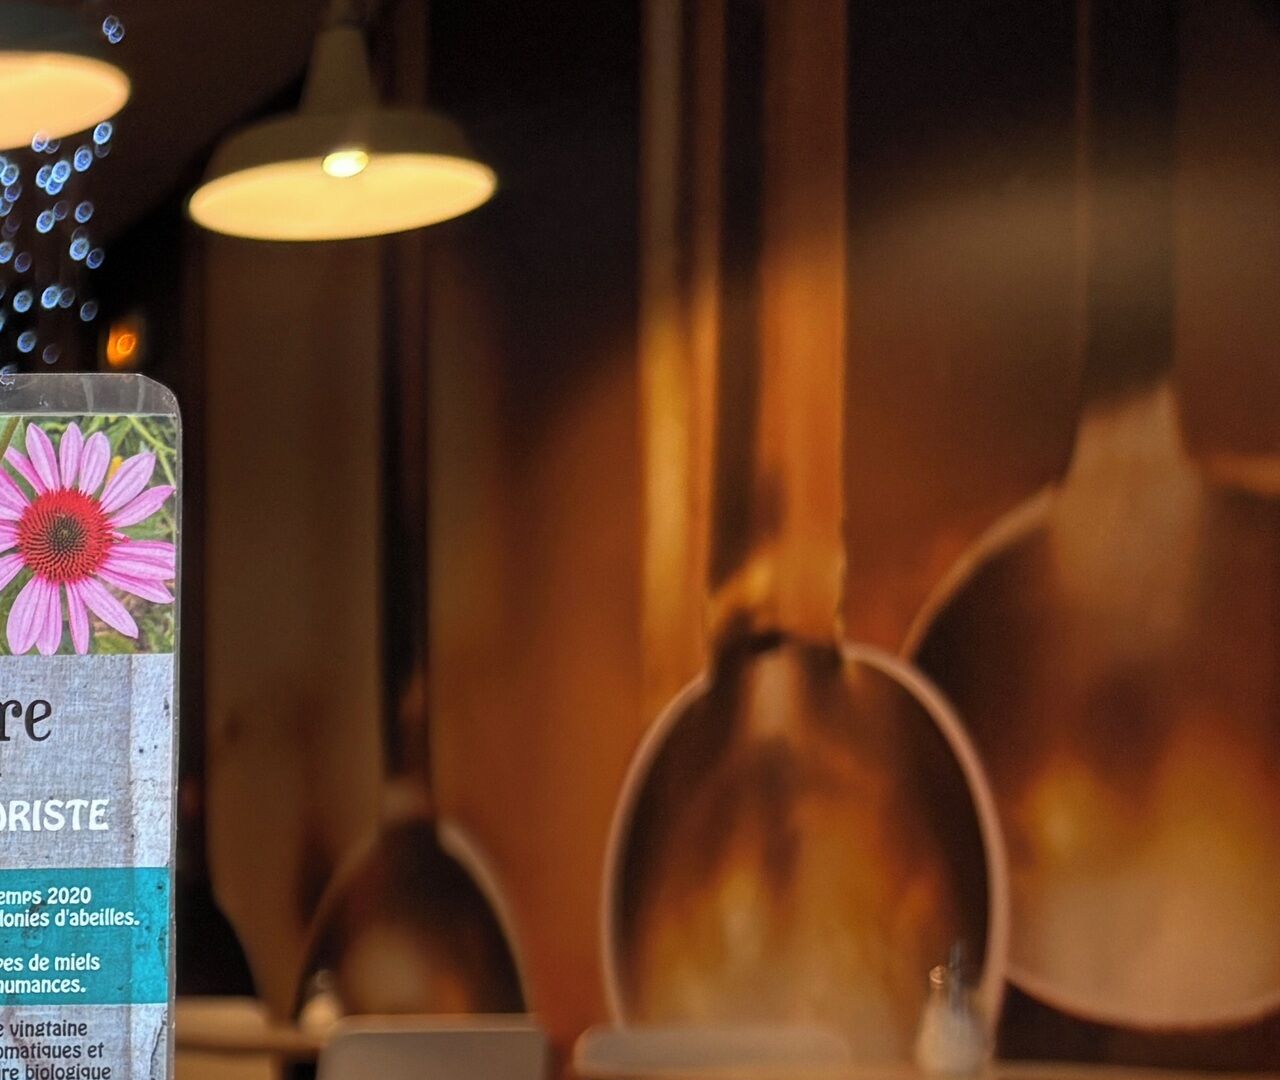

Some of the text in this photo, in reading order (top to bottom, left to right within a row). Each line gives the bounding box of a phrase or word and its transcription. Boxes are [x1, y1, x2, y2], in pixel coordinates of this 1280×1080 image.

[47, 887, 92, 905] 2020
[55, 908, 140, 927] d'abeilles.
[10, 1021, 87, 1037] vingtaine
[87, 1042, 103, 1058] et
[25, 1064, 111, 1080] biologique
